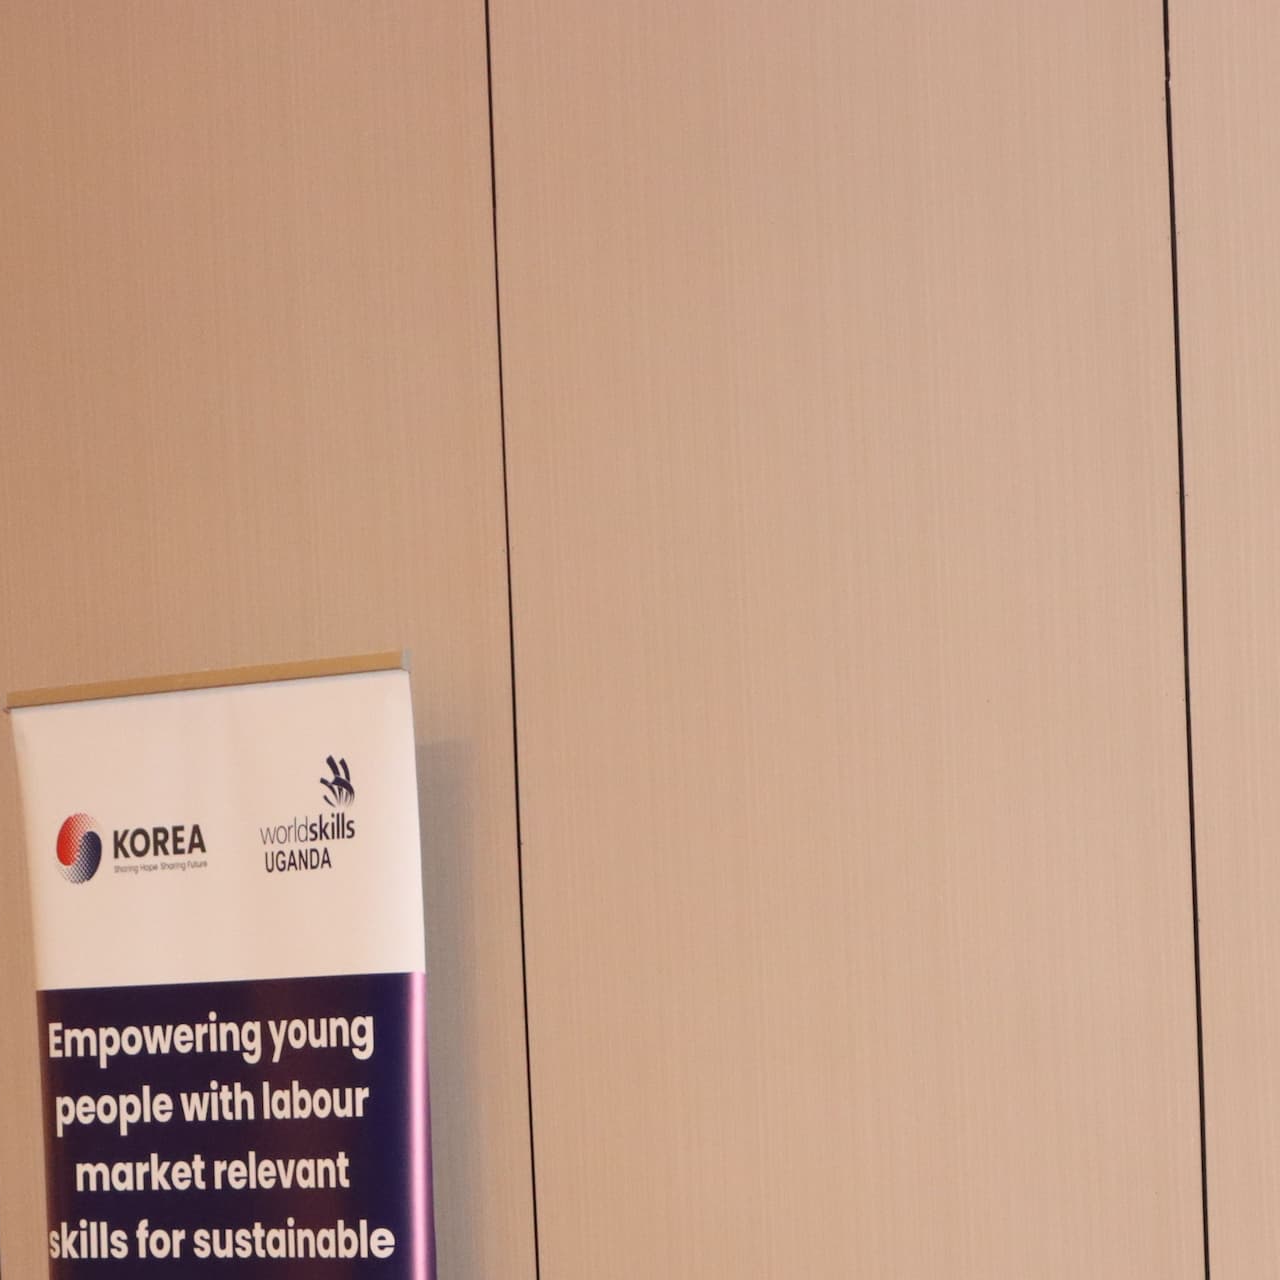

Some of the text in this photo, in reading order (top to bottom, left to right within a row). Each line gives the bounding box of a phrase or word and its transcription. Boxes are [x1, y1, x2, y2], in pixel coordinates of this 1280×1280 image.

[113, 823, 207, 859] KOREA
[260, 812, 356, 845] worldskills
[265, 848, 331, 872] UGANDA
[49, 1011, 374, 1069] Empowering young
[56, 1080, 369, 1138] people with labour
[75, 1151, 350, 1192] market relevant
[49, 1217, 395, 1260] skills for sustainable
